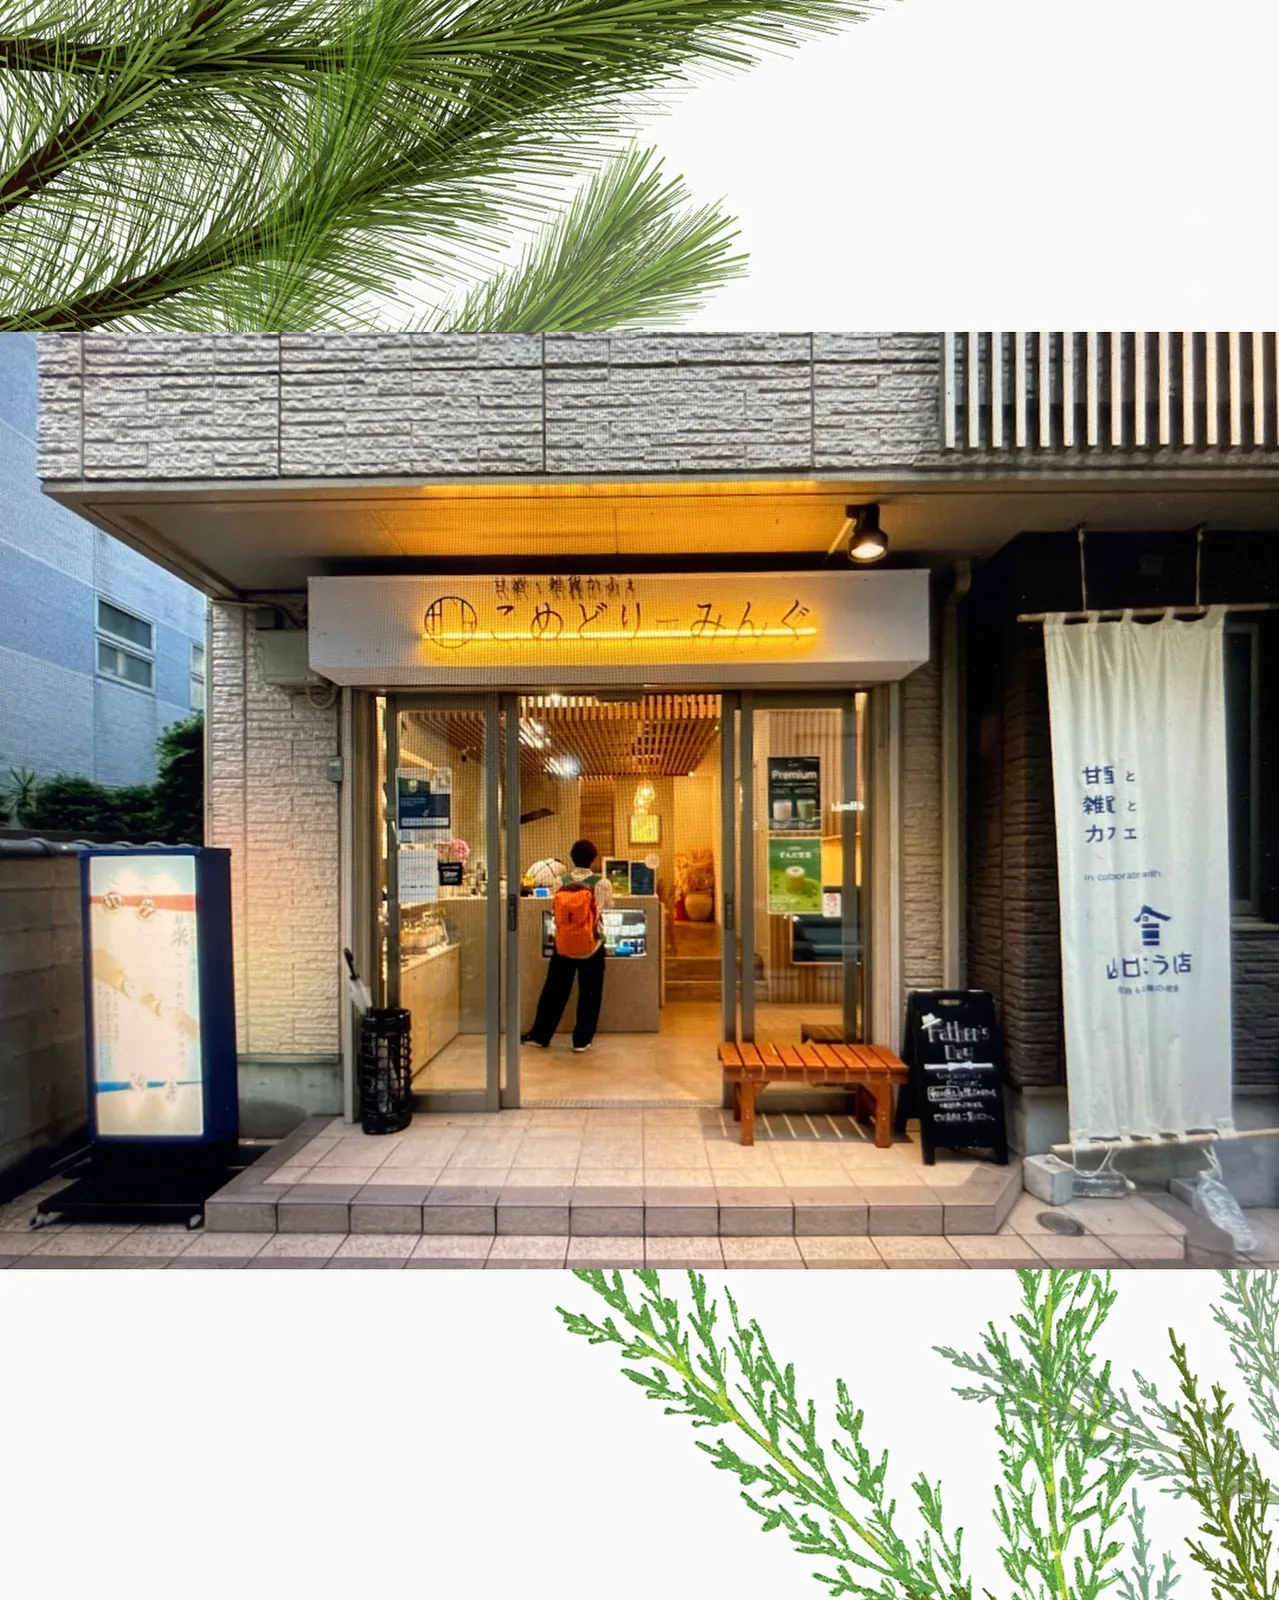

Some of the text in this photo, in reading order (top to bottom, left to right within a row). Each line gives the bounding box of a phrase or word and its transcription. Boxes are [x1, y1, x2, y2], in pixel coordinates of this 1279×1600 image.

[491, 599, 811, 641] こめどりーみんぐ
[771, 770, 817, 779] Premium
